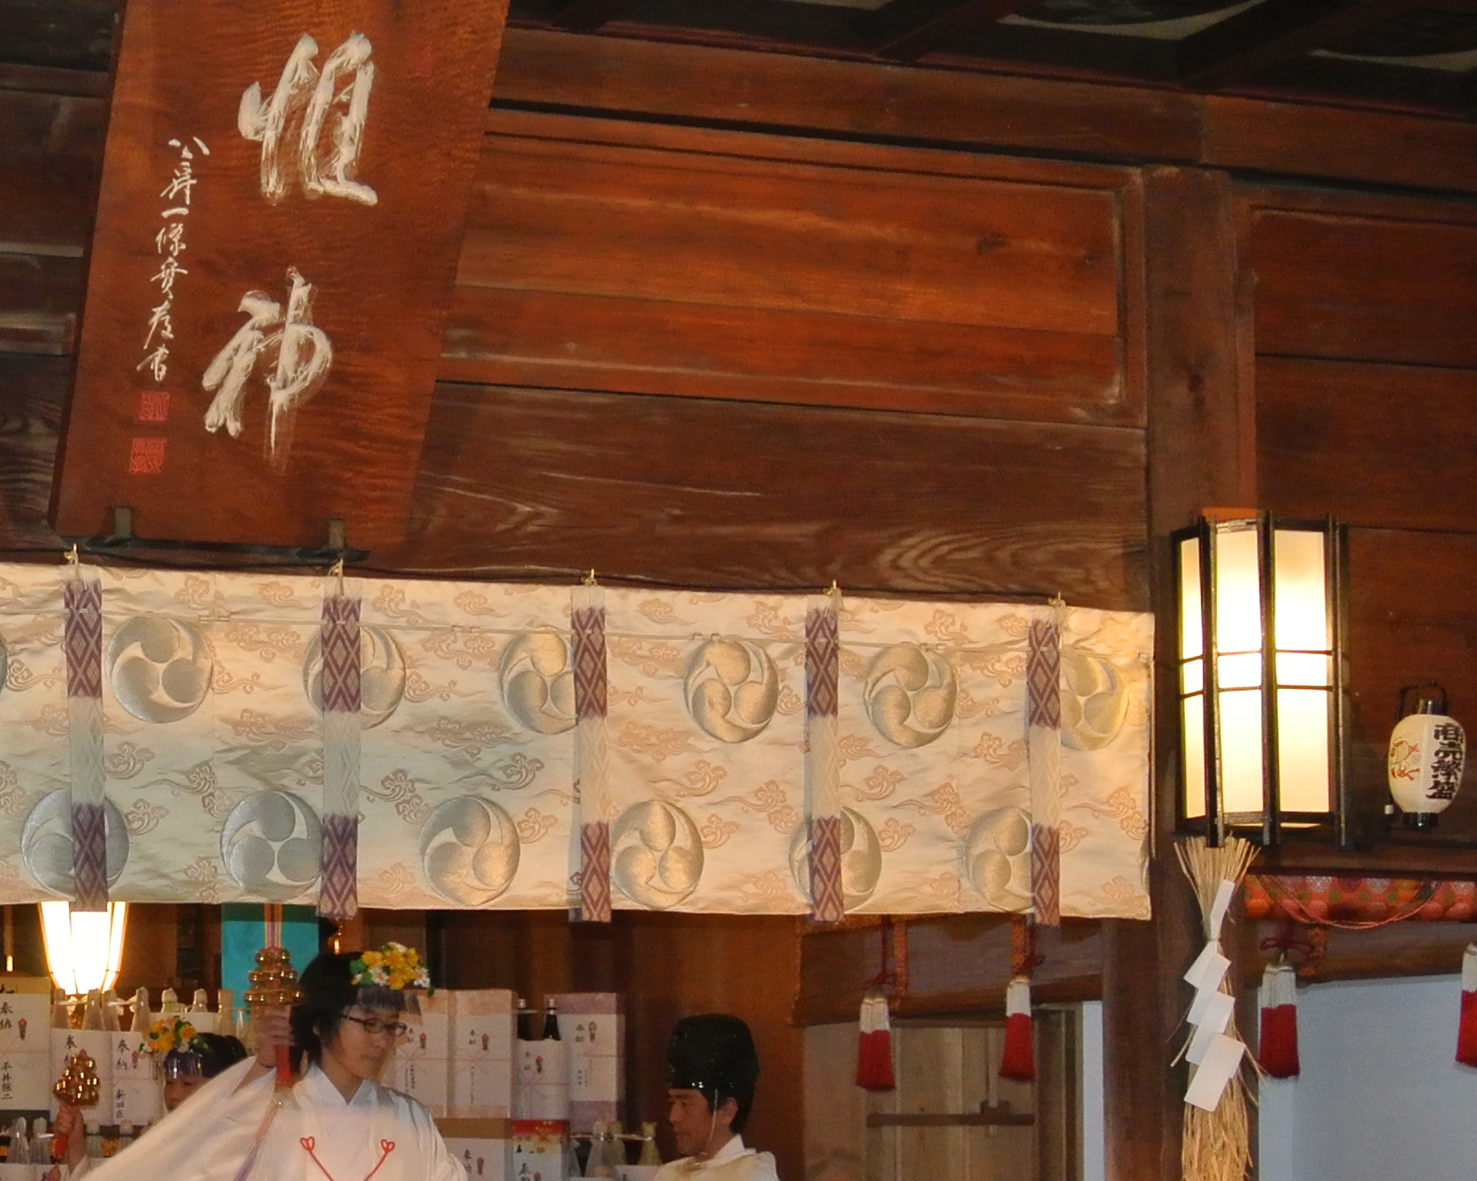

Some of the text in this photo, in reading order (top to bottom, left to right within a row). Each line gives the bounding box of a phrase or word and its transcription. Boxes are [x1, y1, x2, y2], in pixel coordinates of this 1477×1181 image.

[1426, 722, 1464, 800] 商売繁盛
[116, 1039, 130, 1071] 奉納
